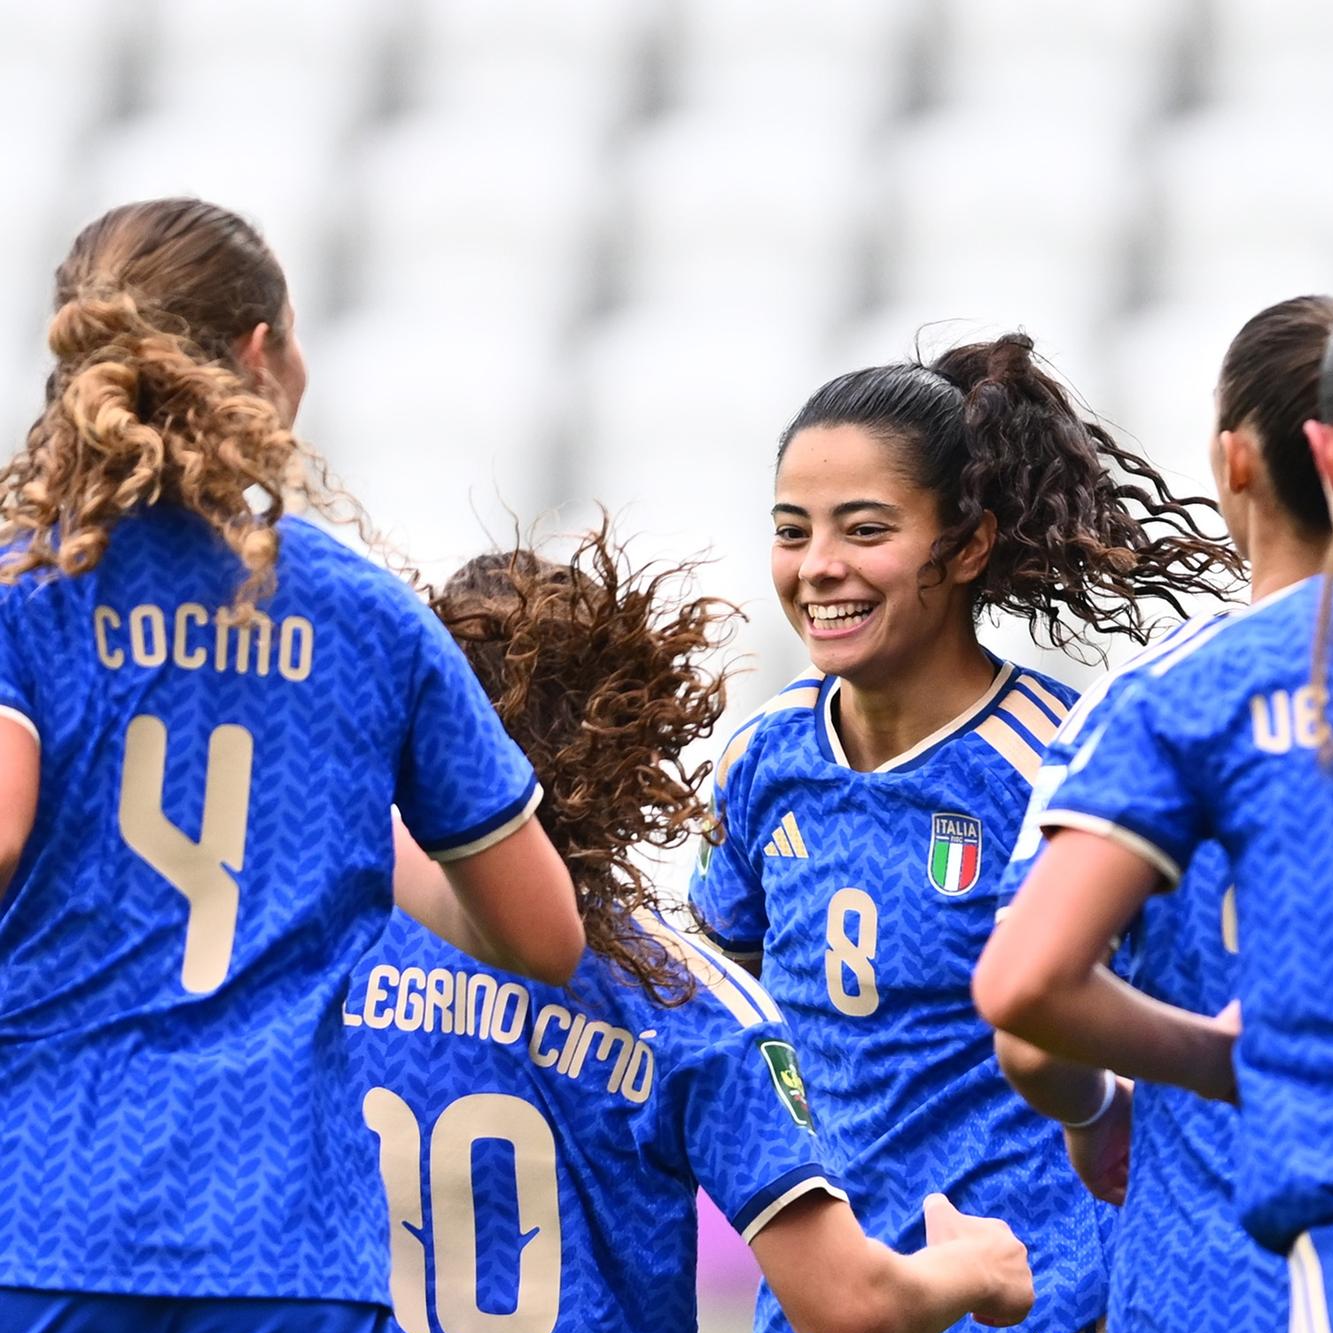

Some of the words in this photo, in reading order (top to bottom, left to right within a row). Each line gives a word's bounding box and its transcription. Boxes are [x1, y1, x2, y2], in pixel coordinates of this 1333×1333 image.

[119, 715, 254, 994] 4
[935, 818, 977, 838] ITALIA
[825, 888, 879, 1017] 8
